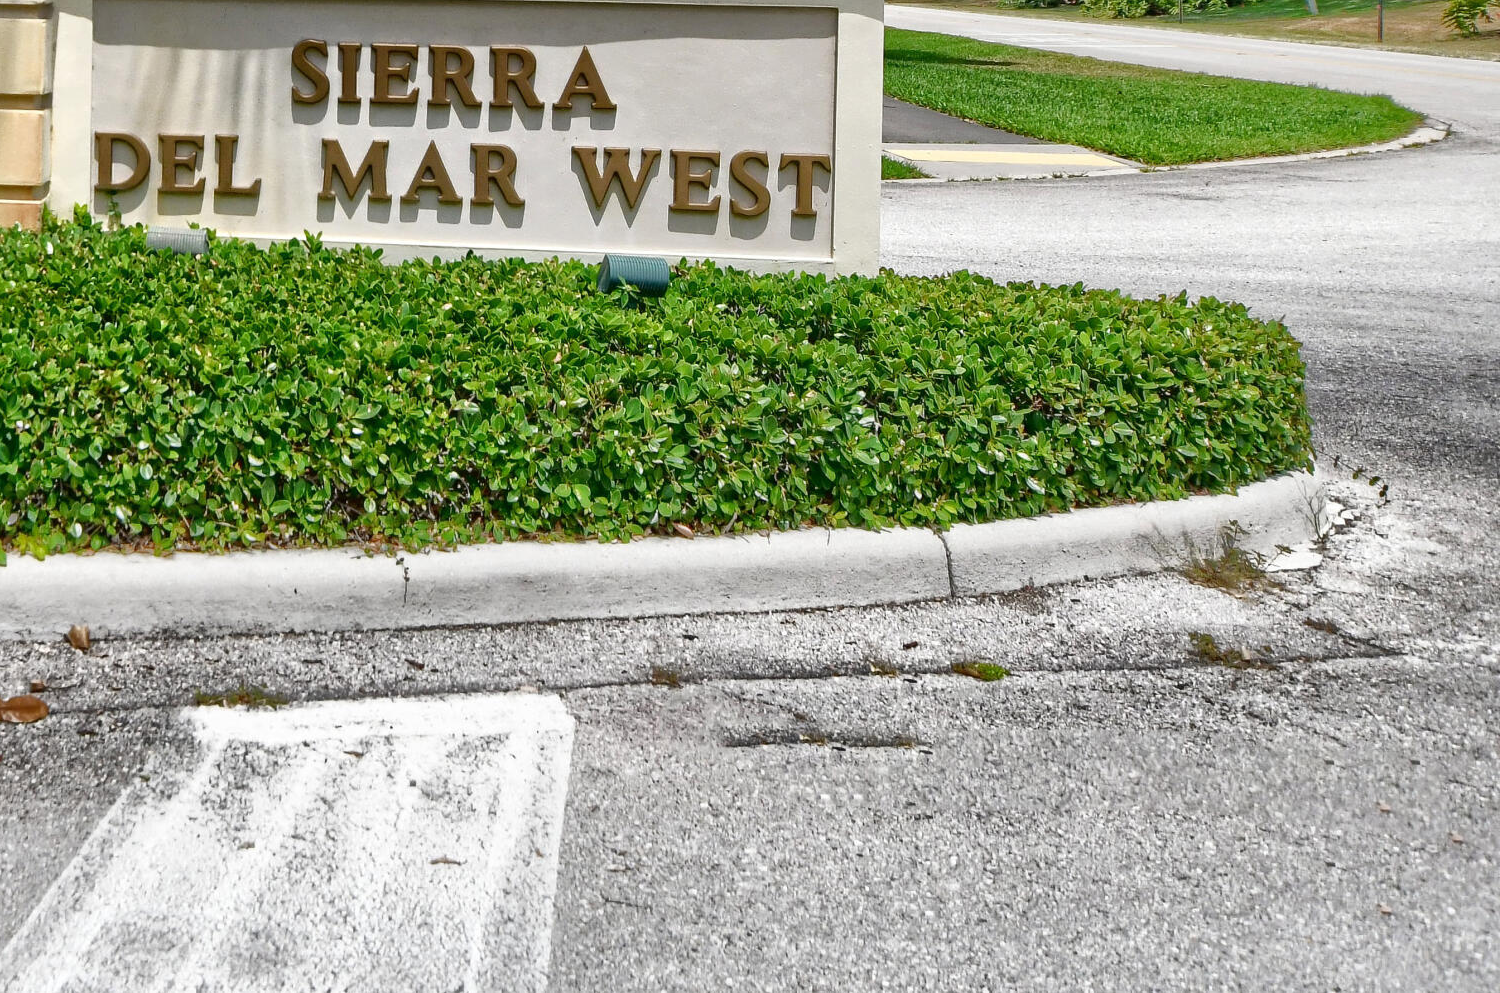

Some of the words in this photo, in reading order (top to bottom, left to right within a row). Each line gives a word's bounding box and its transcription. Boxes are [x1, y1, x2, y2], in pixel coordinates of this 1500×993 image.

[291, 38, 618, 111] SIERRA
[94, 131, 261, 197] DEL
[320, 138, 526, 208] MAR
[571, 146, 832, 218] WEST
